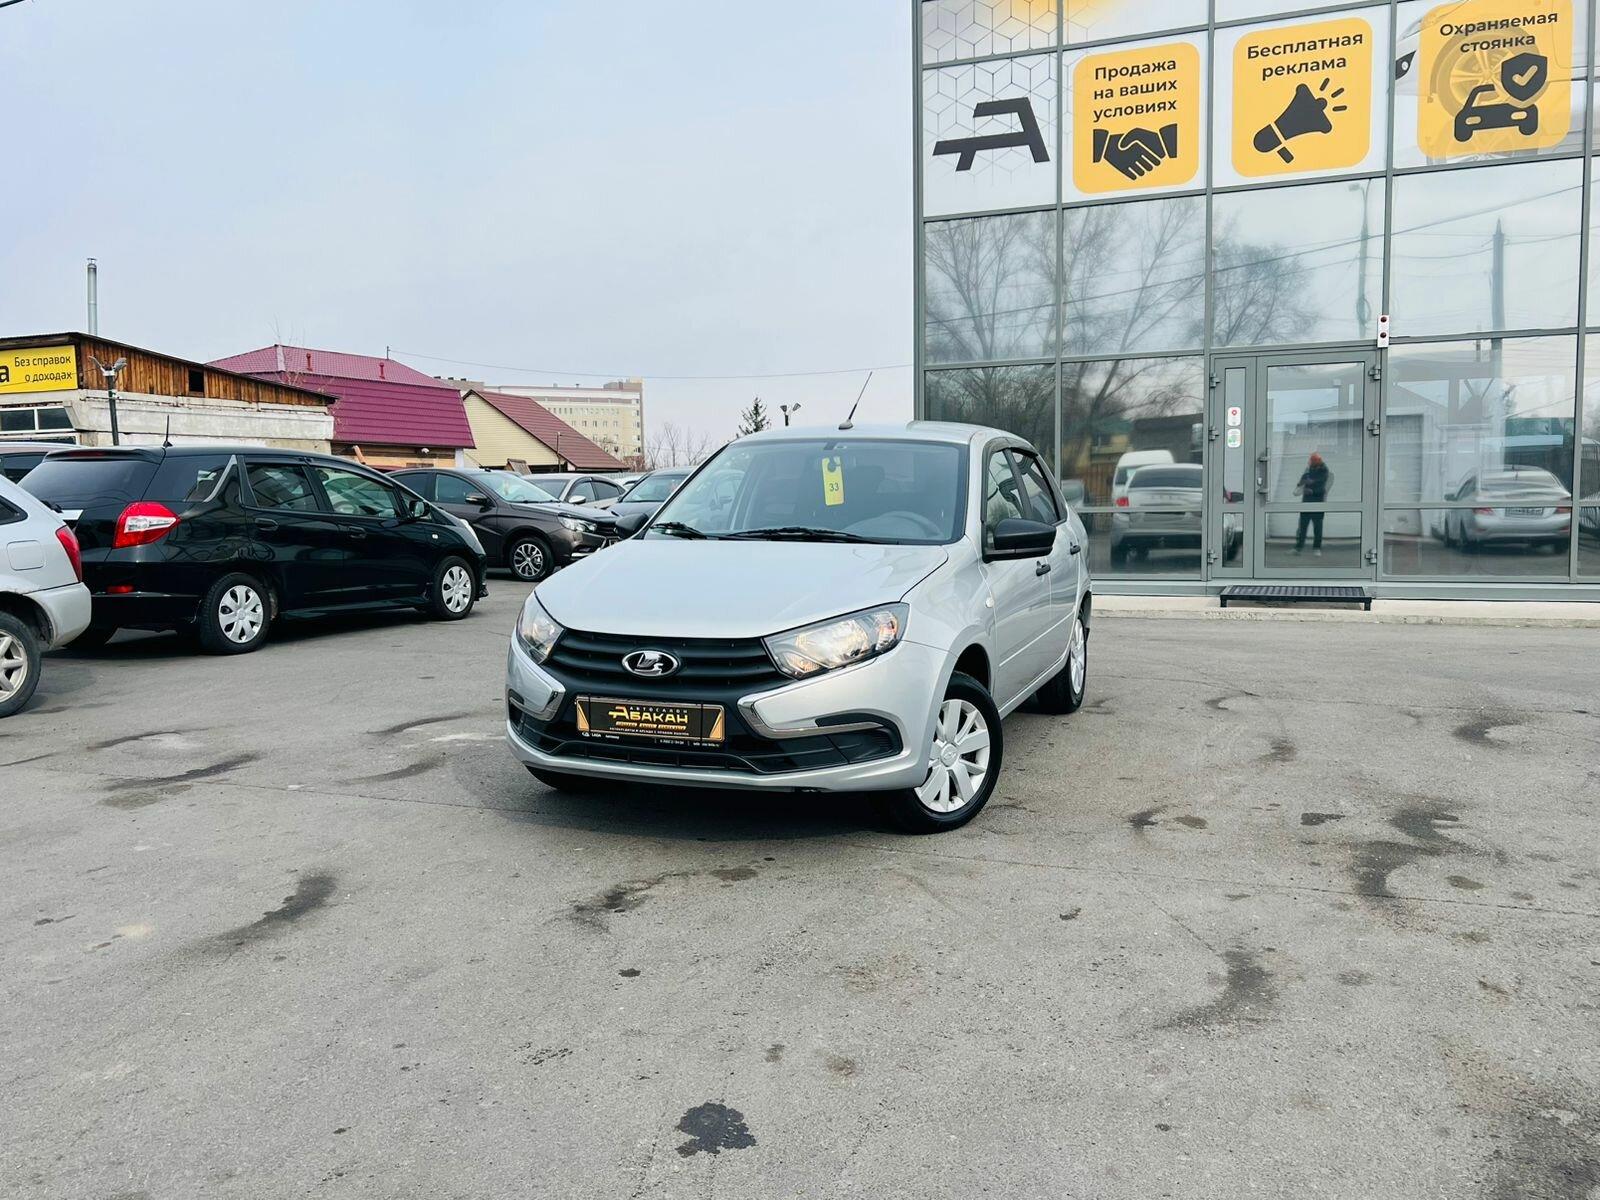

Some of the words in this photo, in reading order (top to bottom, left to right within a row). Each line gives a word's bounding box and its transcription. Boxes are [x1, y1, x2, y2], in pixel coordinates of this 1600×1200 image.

[1439, 12, 1559, 37] Охраняемая
[1247, 33, 1363, 59] Бесплатная
[1460, 35, 1536, 53] стоянка
[1095, 59, 1177, 81] Продажа
[1262, 57, 1347, 81] реклама
[1093, 88, 1114, 100] на
[1119, 79, 1178, 97] ваших
[1093, 99, 1177, 123] условиях
[14, 356, 31, 367] Без
[32, 356, 72, 367] справок
[24, 373, 31, 382] о
[32, 371, 73, 382] доходах
[829, 482, 840, 492] 33
